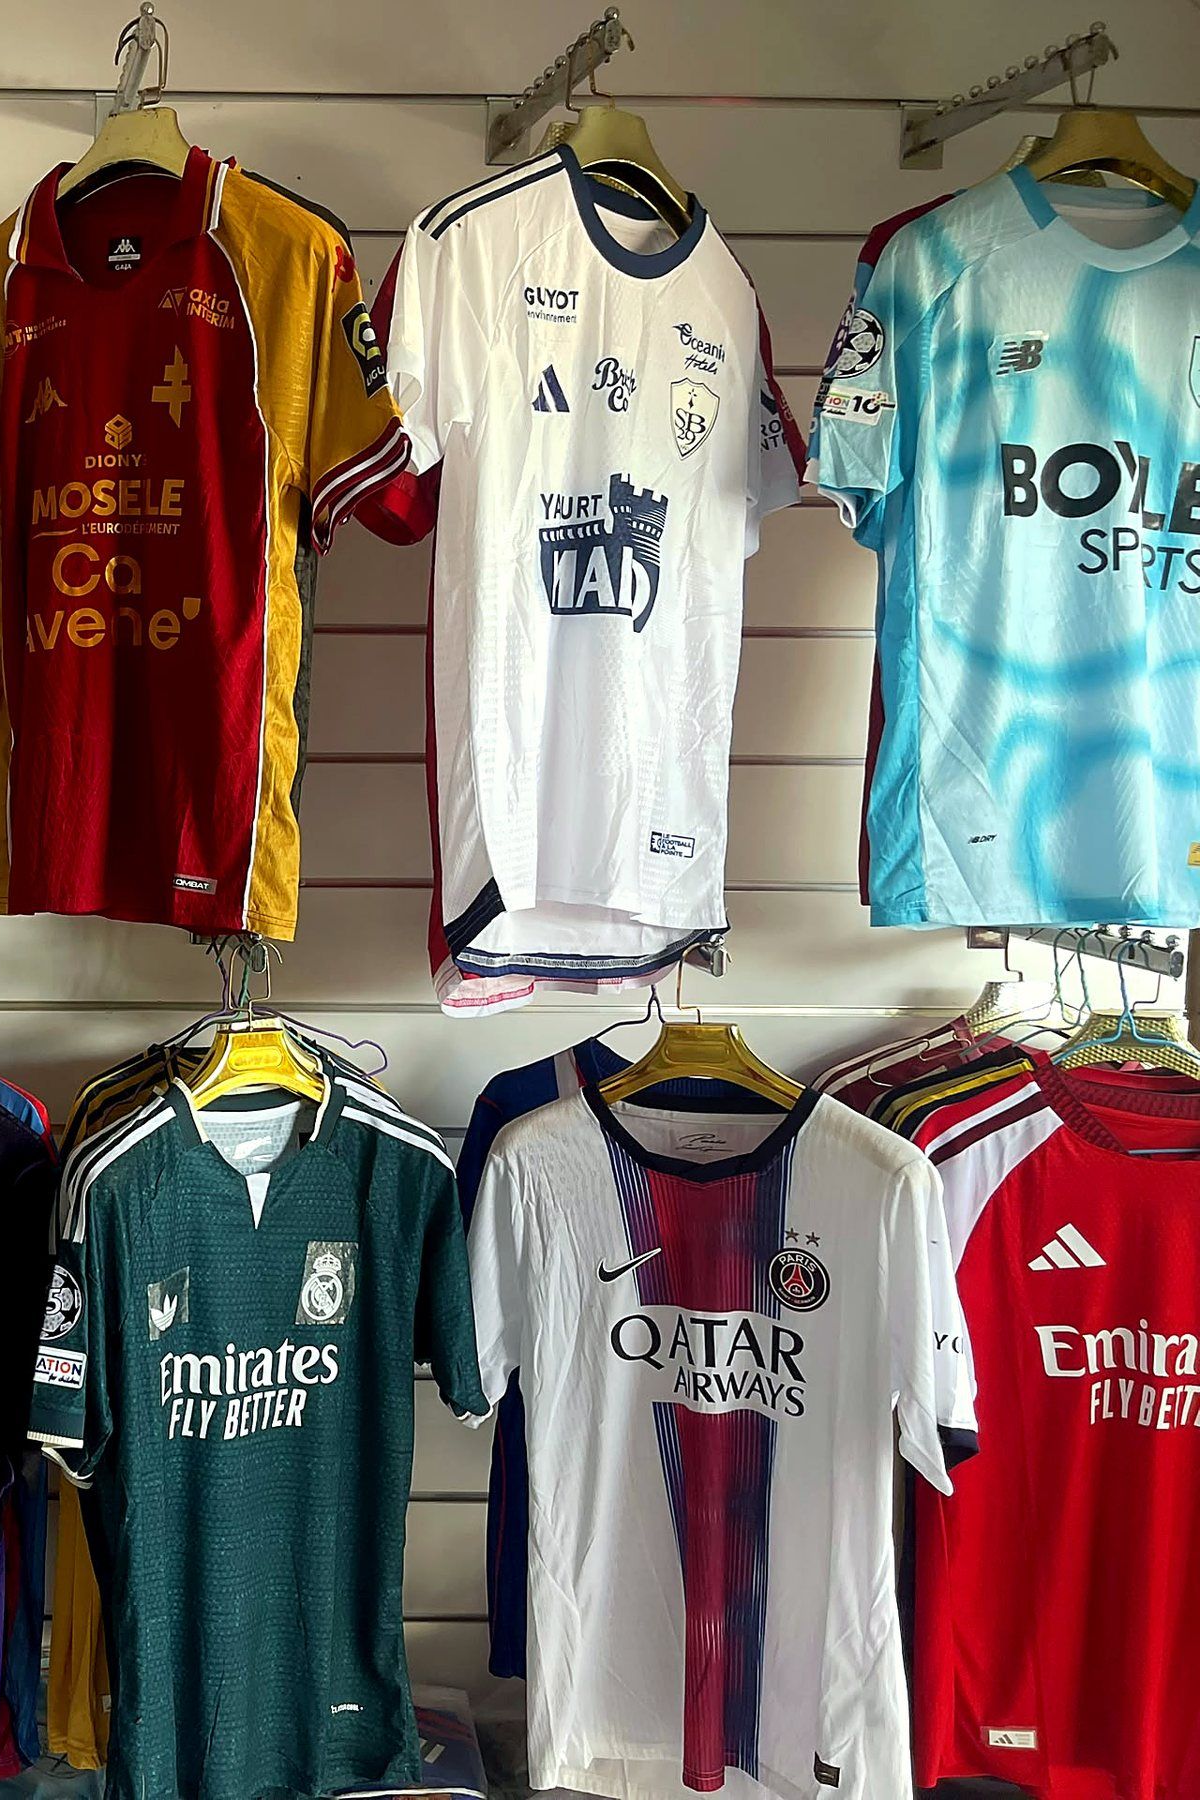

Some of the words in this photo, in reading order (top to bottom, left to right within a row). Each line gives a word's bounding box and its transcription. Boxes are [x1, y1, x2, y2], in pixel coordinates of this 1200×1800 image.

[189, 288, 230, 313] axia
[523, 286, 579, 311] GUYOT
[187, 302, 235, 330] INTERIM
[675, 407, 706, 435] SB
[677, 427, 696, 446] 29
[778, 1253, 817, 1273] PARIS
[610, 1313, 807, 1384] QATAR
[159, 1337, 339, 1408] Emirates
[673, 1365, 805, 1417] AIRWAYS
[1090, 1378, 1135, 1425] FLY
[168, 1397, 217, 1440] FLY
[223, 1387, 308, 1441] BETTER
